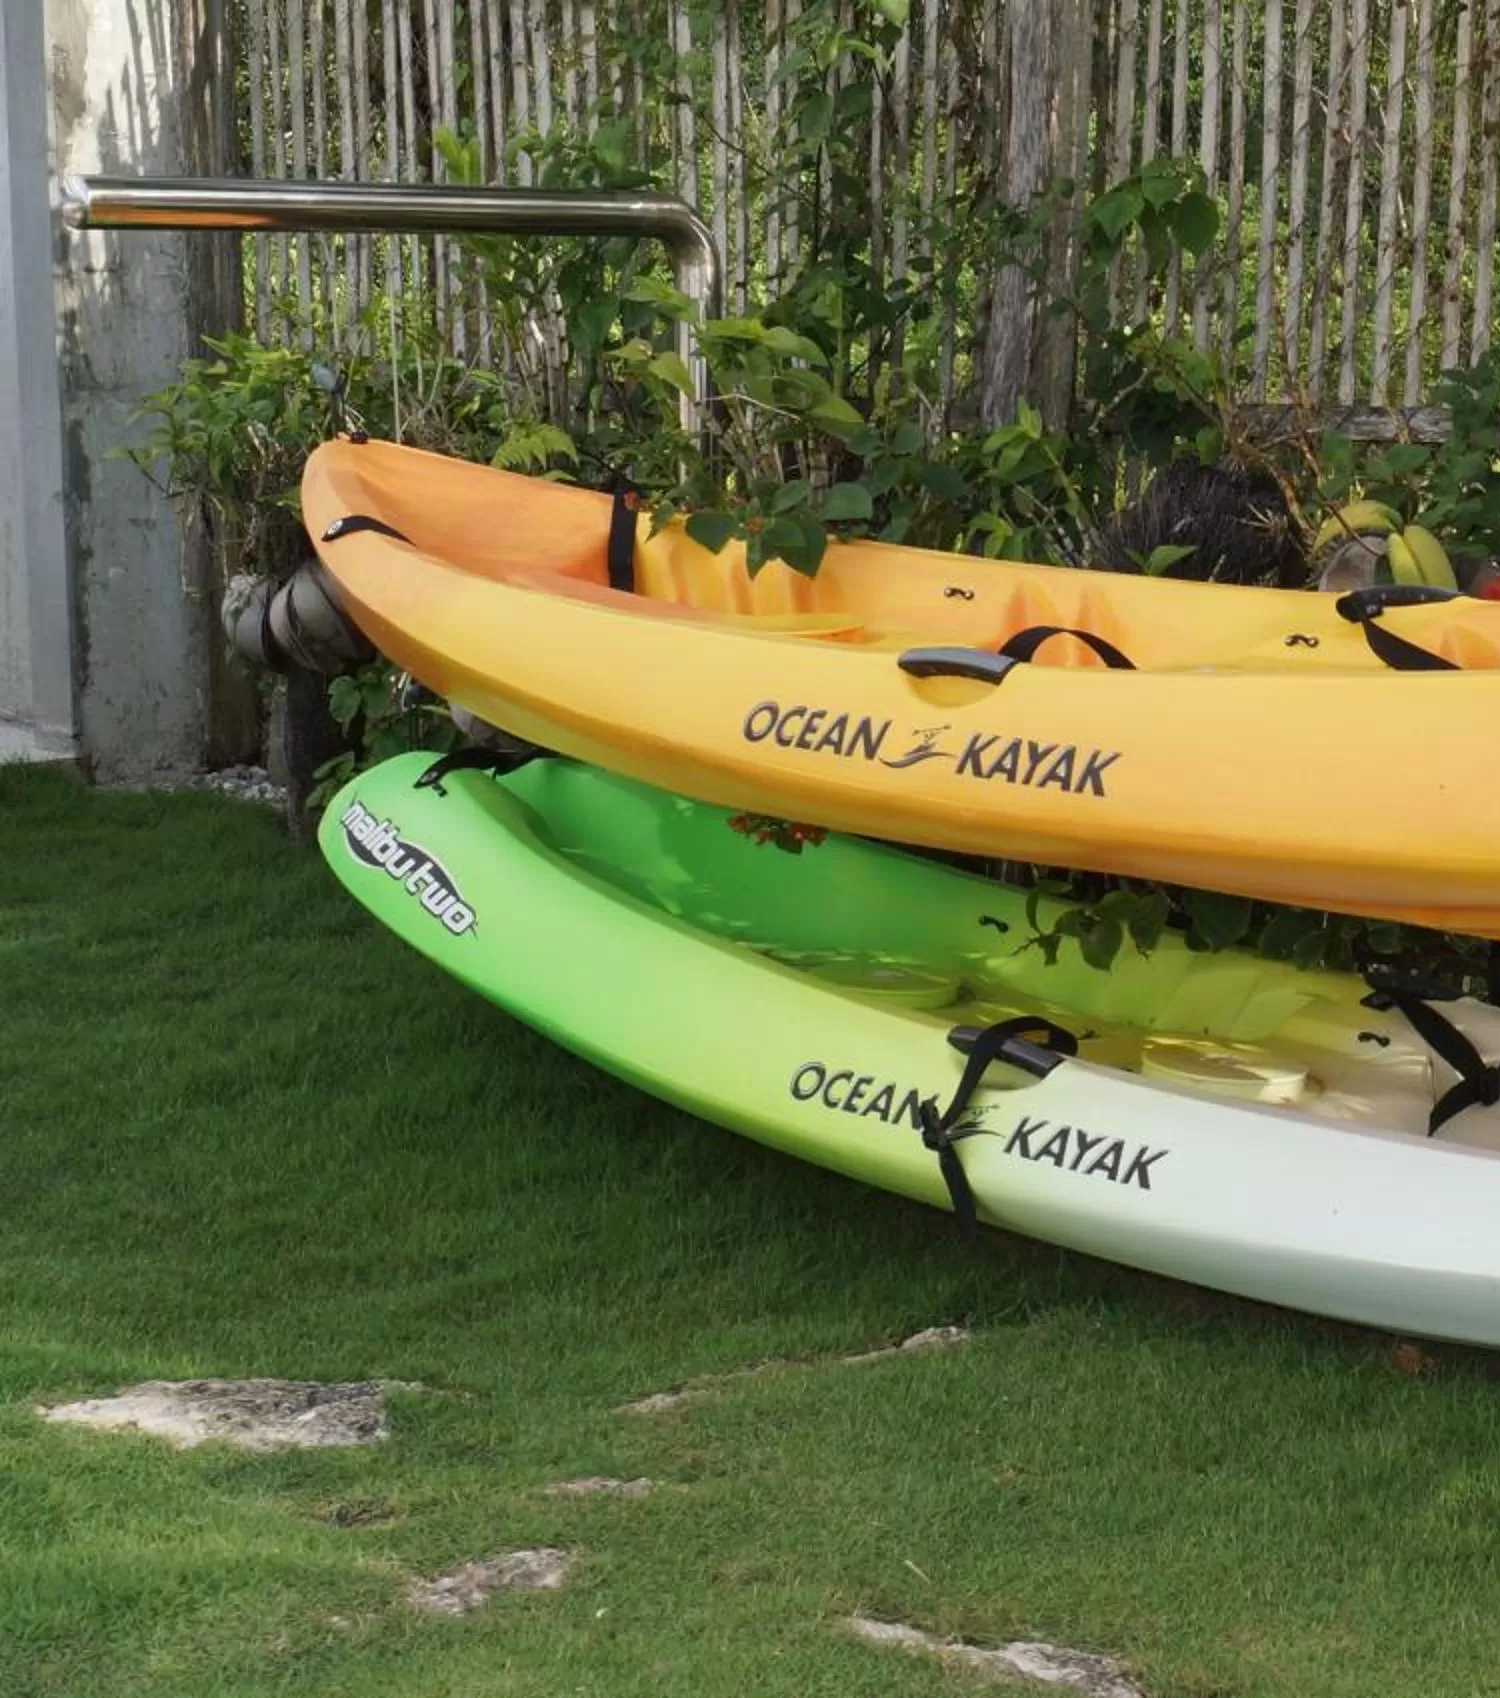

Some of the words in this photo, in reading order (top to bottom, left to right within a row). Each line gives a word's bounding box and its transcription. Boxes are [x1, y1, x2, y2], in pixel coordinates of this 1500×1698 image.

[743, 701, 892, 761] OCEAN
[956, 732, 1122, 797] KAYAK
[340, 800, 416, 880] malibu
[404, 861, 477, 936] two
[1004, 1115, 1169, 1190] KAYAK
